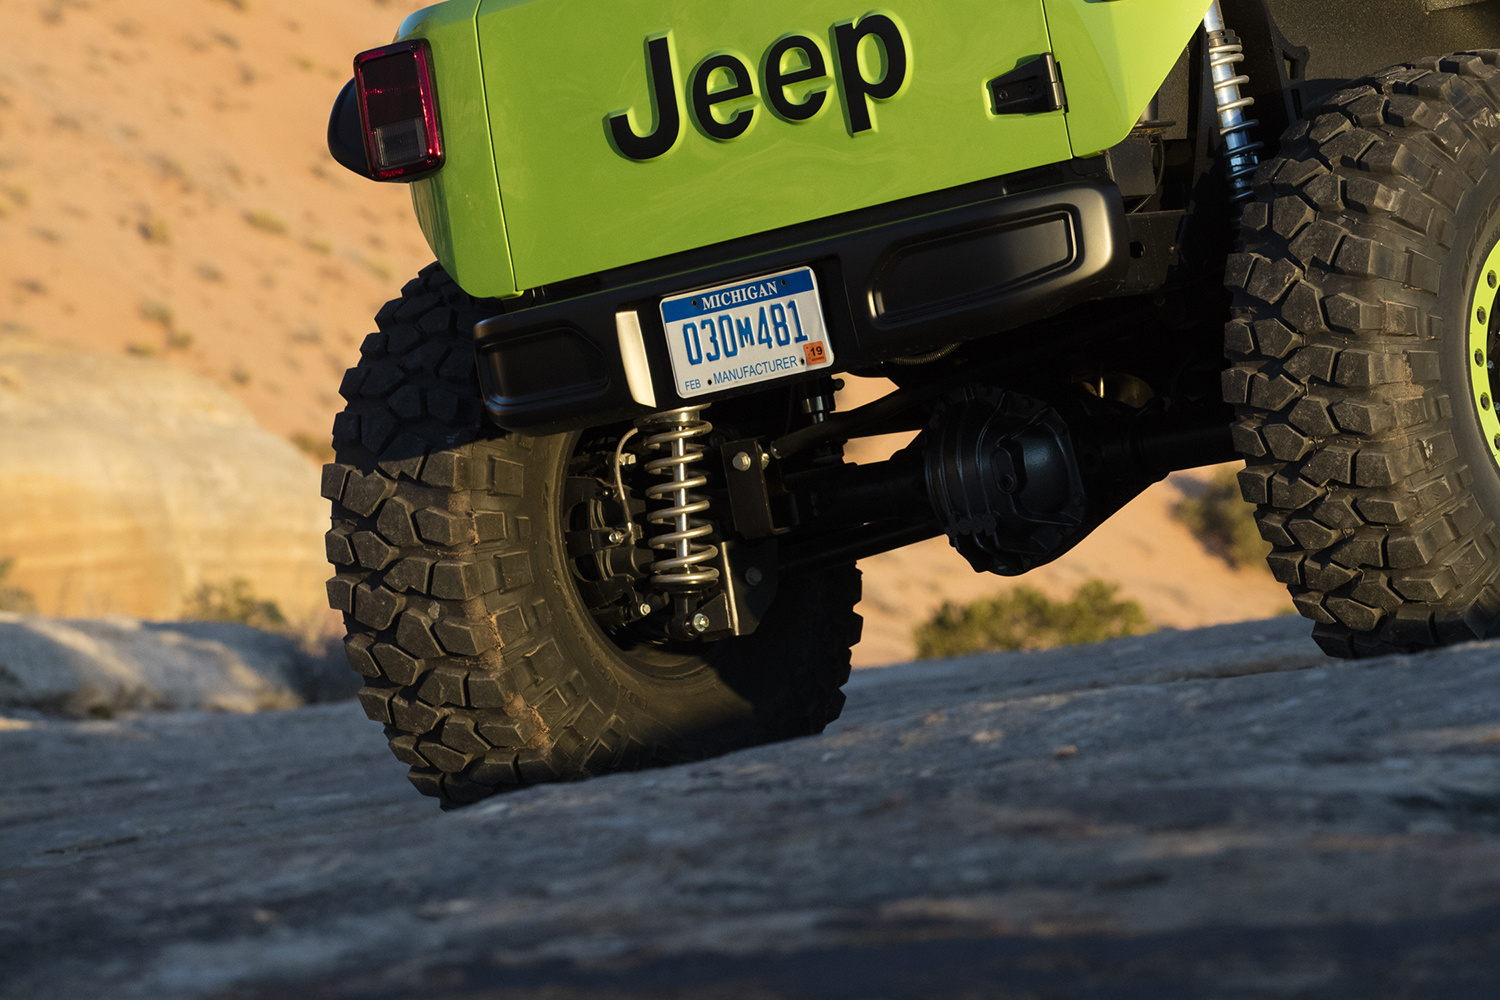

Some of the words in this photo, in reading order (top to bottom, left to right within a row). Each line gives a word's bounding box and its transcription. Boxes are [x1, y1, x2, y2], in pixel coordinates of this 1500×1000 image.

[605, 11, 911, 163] Jeep
[701, 281, 779, 311] MICHIGAN
[682, 299, 809, 366] 030M481
[810, 345, 823, 356] 19
[684, 378, 702, 391] FEB
[712, 355, 799, 385] MANUFACTURER
